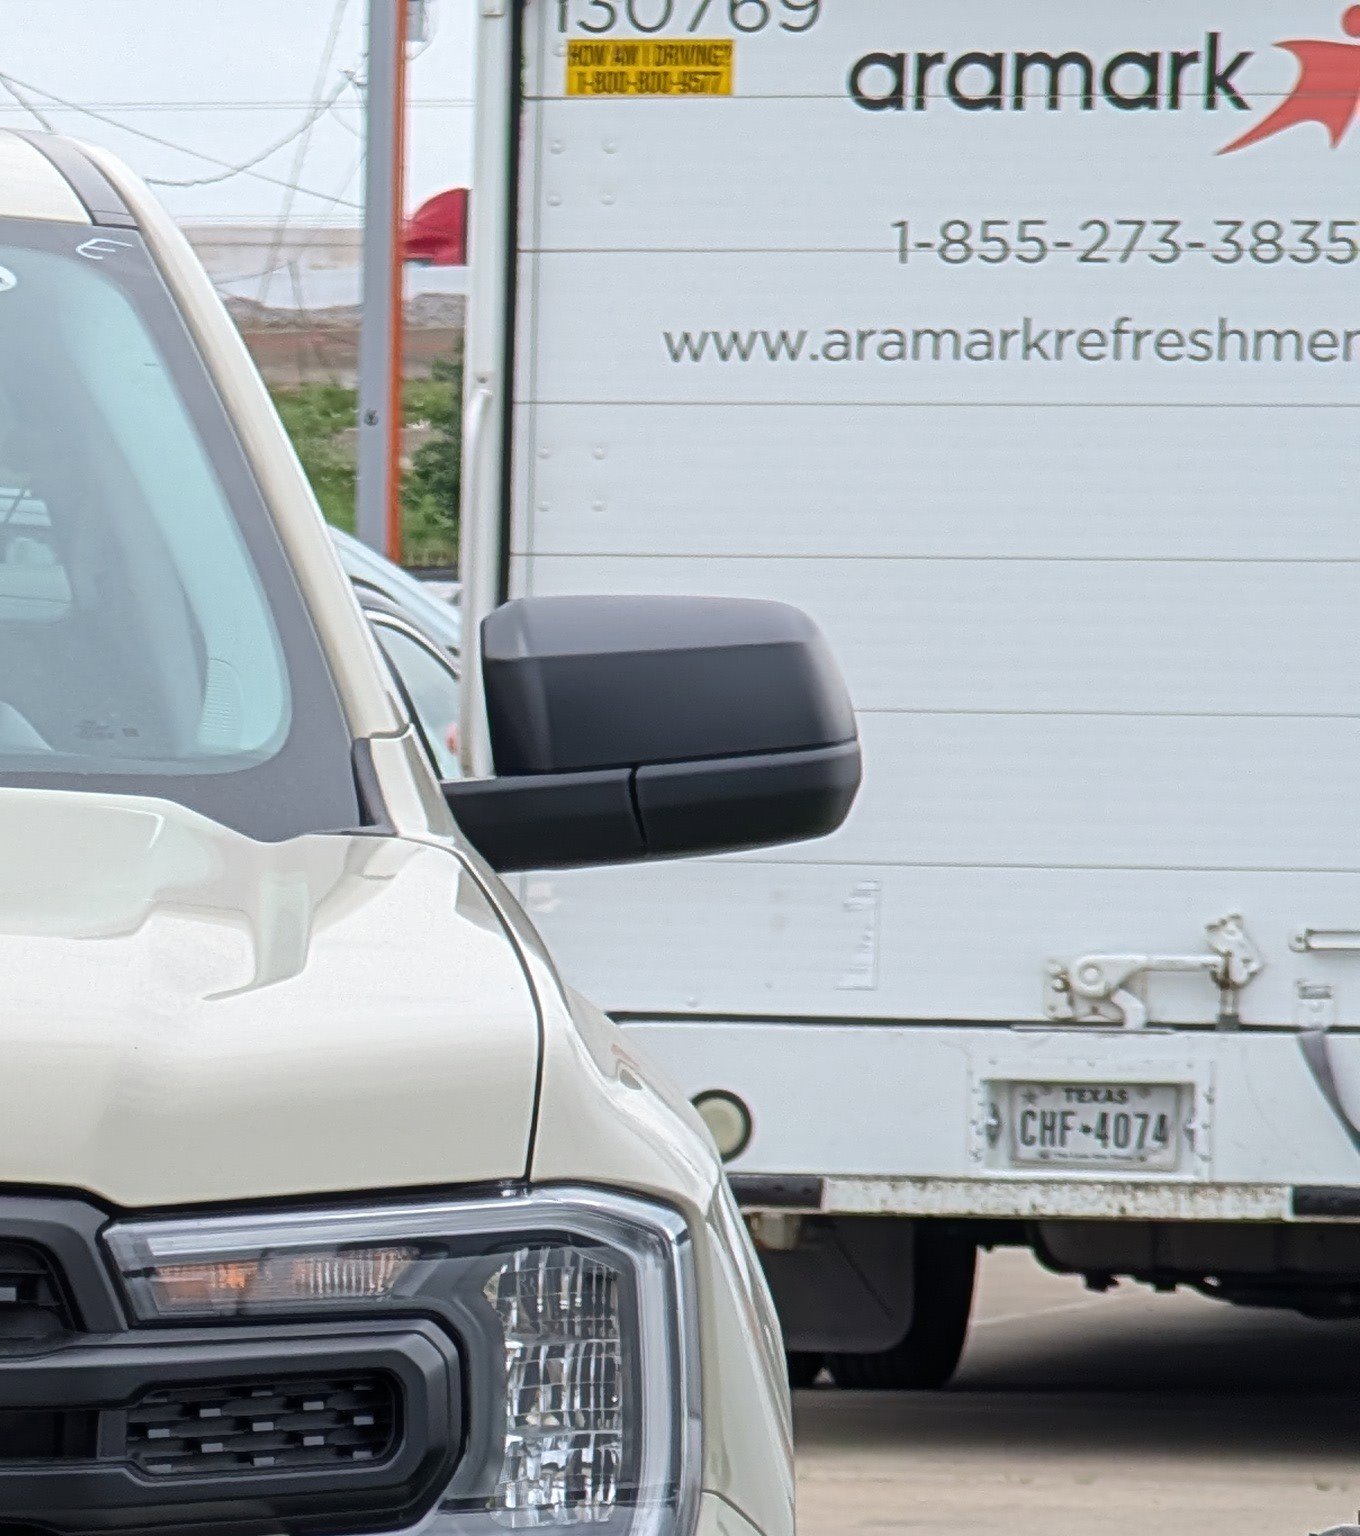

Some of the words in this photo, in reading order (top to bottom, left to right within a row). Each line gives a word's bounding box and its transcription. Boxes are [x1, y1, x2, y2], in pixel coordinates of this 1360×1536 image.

[847, 31, 1255, 112] aramark
[890, 218, 1359, 264] 1-855-273-3835
[1064, 1088, 1129, 1104] TEXAS
